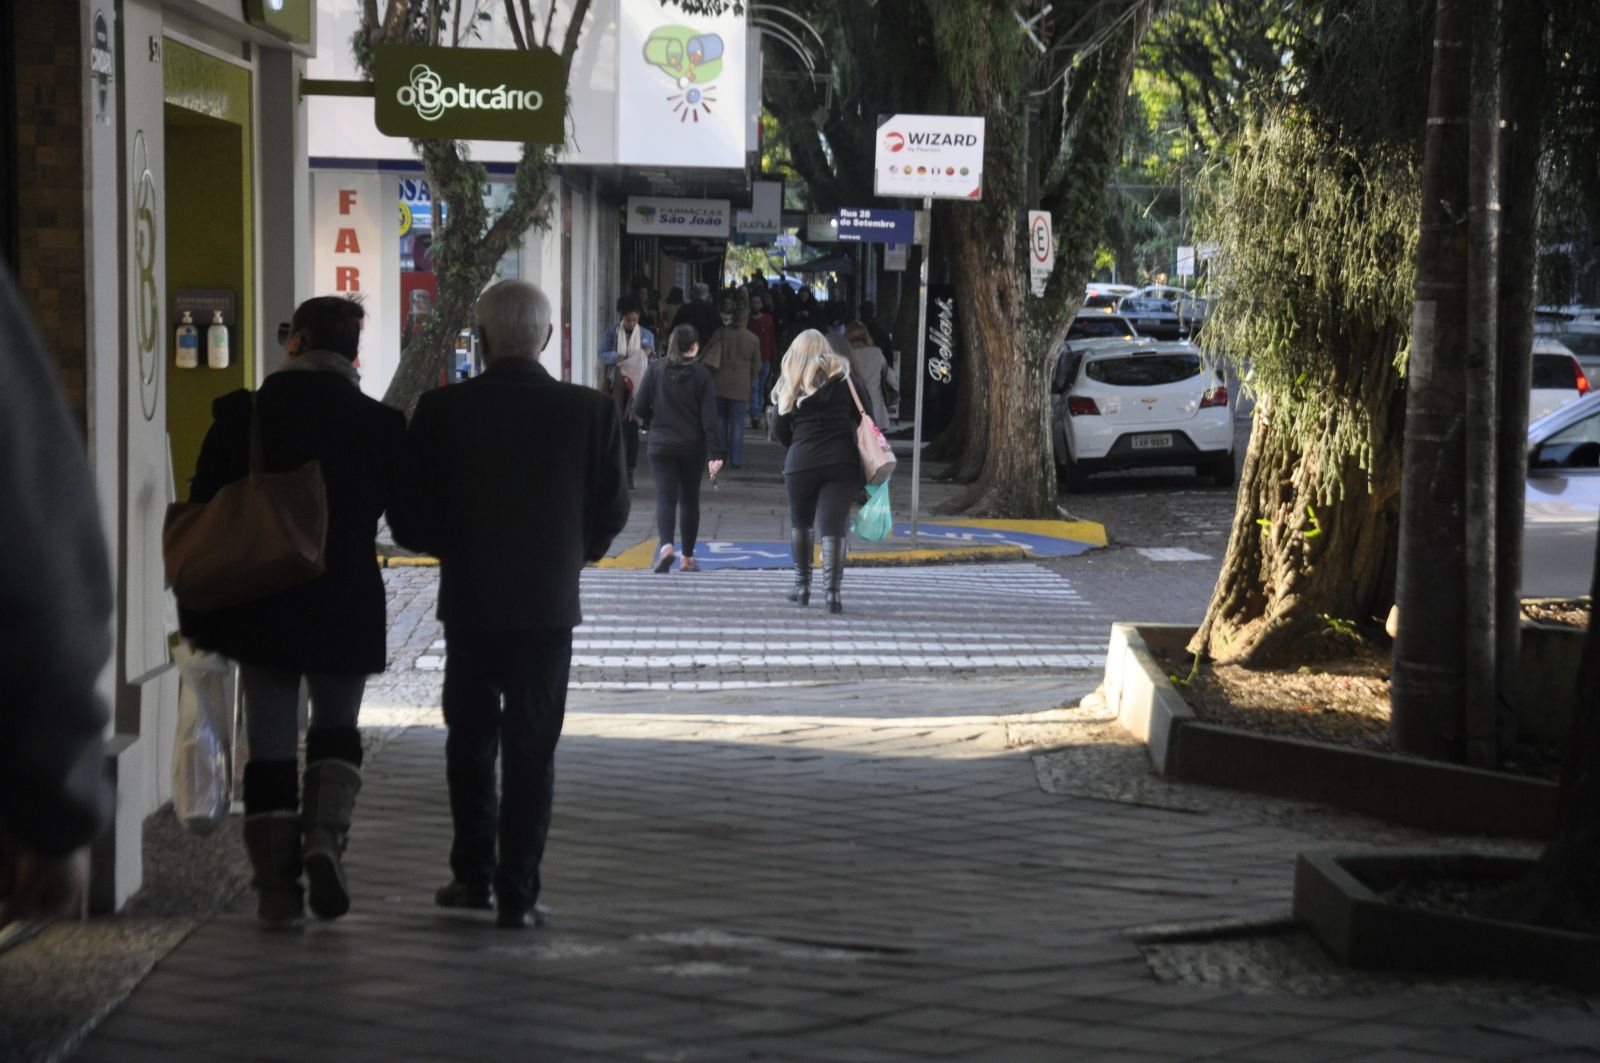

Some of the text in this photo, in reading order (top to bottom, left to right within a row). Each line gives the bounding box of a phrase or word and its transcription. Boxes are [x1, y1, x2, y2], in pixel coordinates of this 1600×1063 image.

[908, 132, 977, 147] WIZARD
[400, 179, 431, 200] SA
[659, 213, 722, 226] São João
[840, 209, 857, 218] Rua
[840, 218, 851, 226] de
[853, 219, 896, 228] Setembro
[1036, 226, 1045, 252] E
